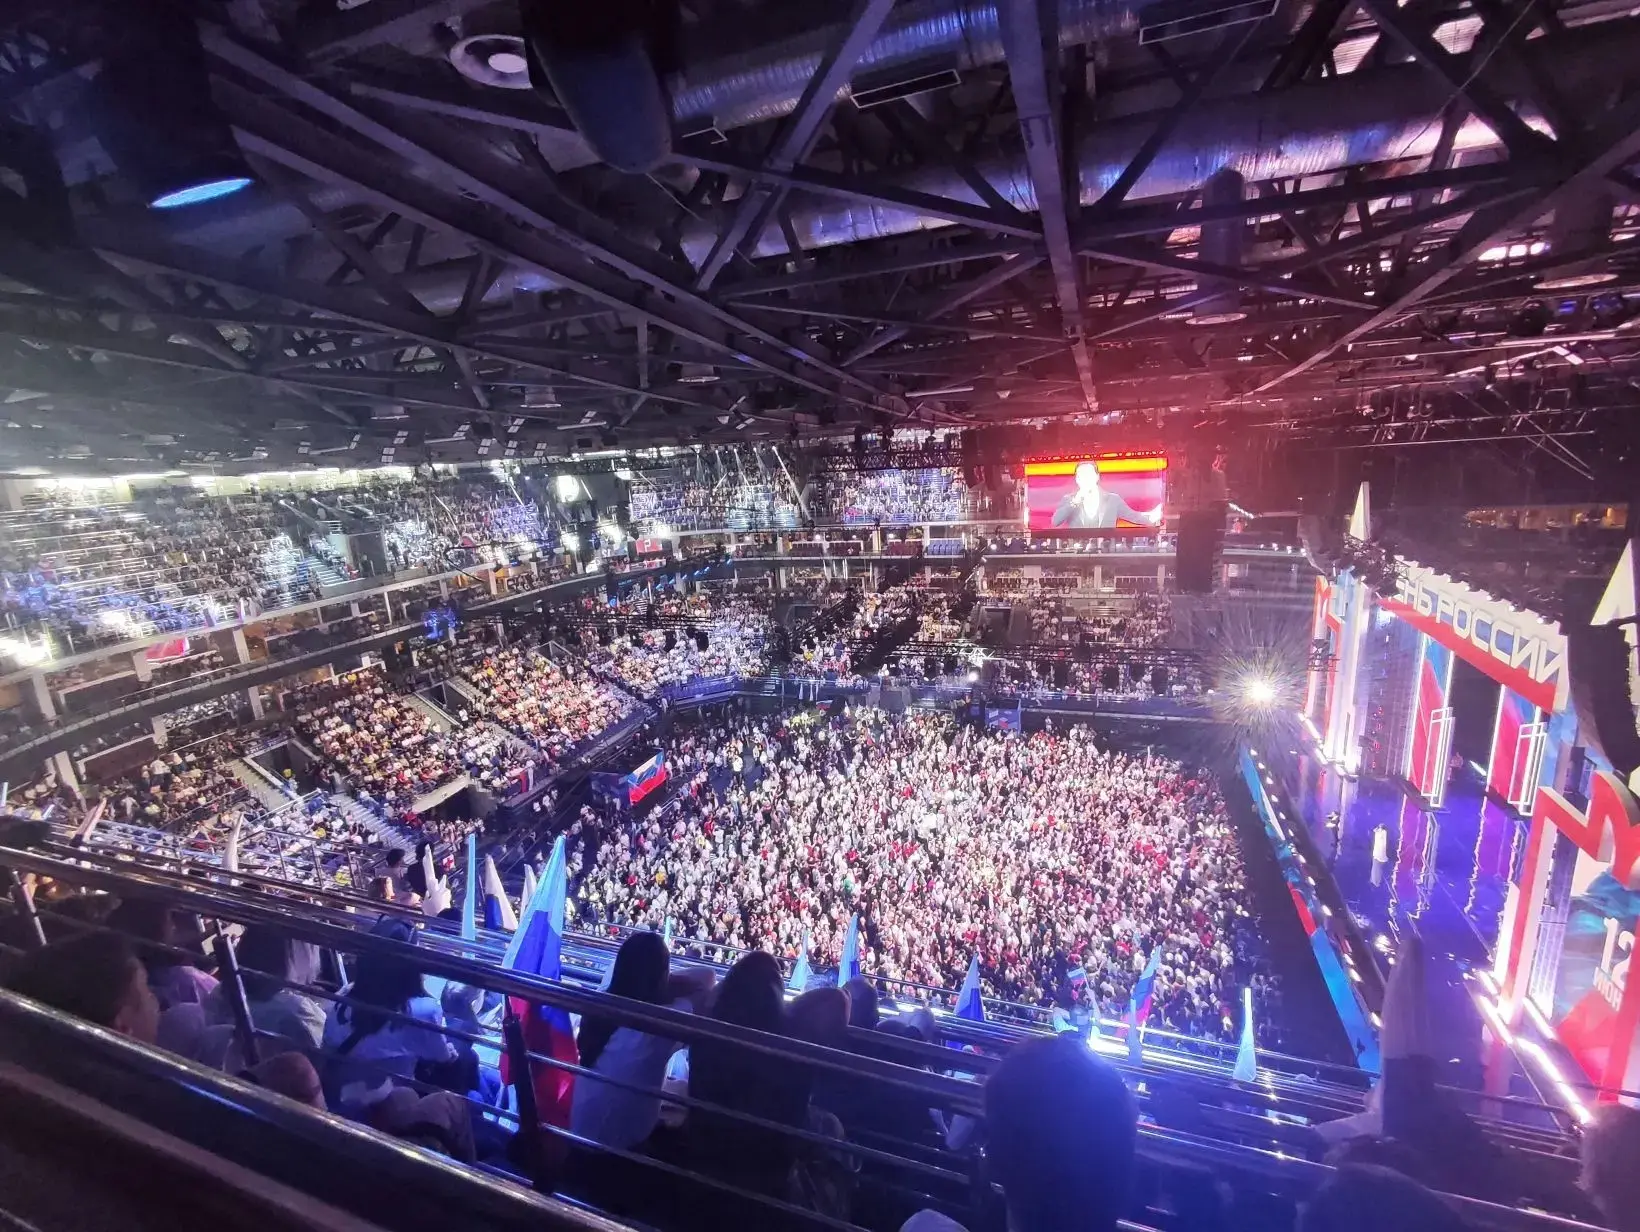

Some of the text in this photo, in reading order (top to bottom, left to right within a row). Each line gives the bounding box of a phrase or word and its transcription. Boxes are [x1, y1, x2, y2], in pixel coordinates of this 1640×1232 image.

[1436, 590, 1565, 702] РОССИИ
[1593, 966, 1623, 1012] ИЮН
[1601, 917, 1635, 993] 12
